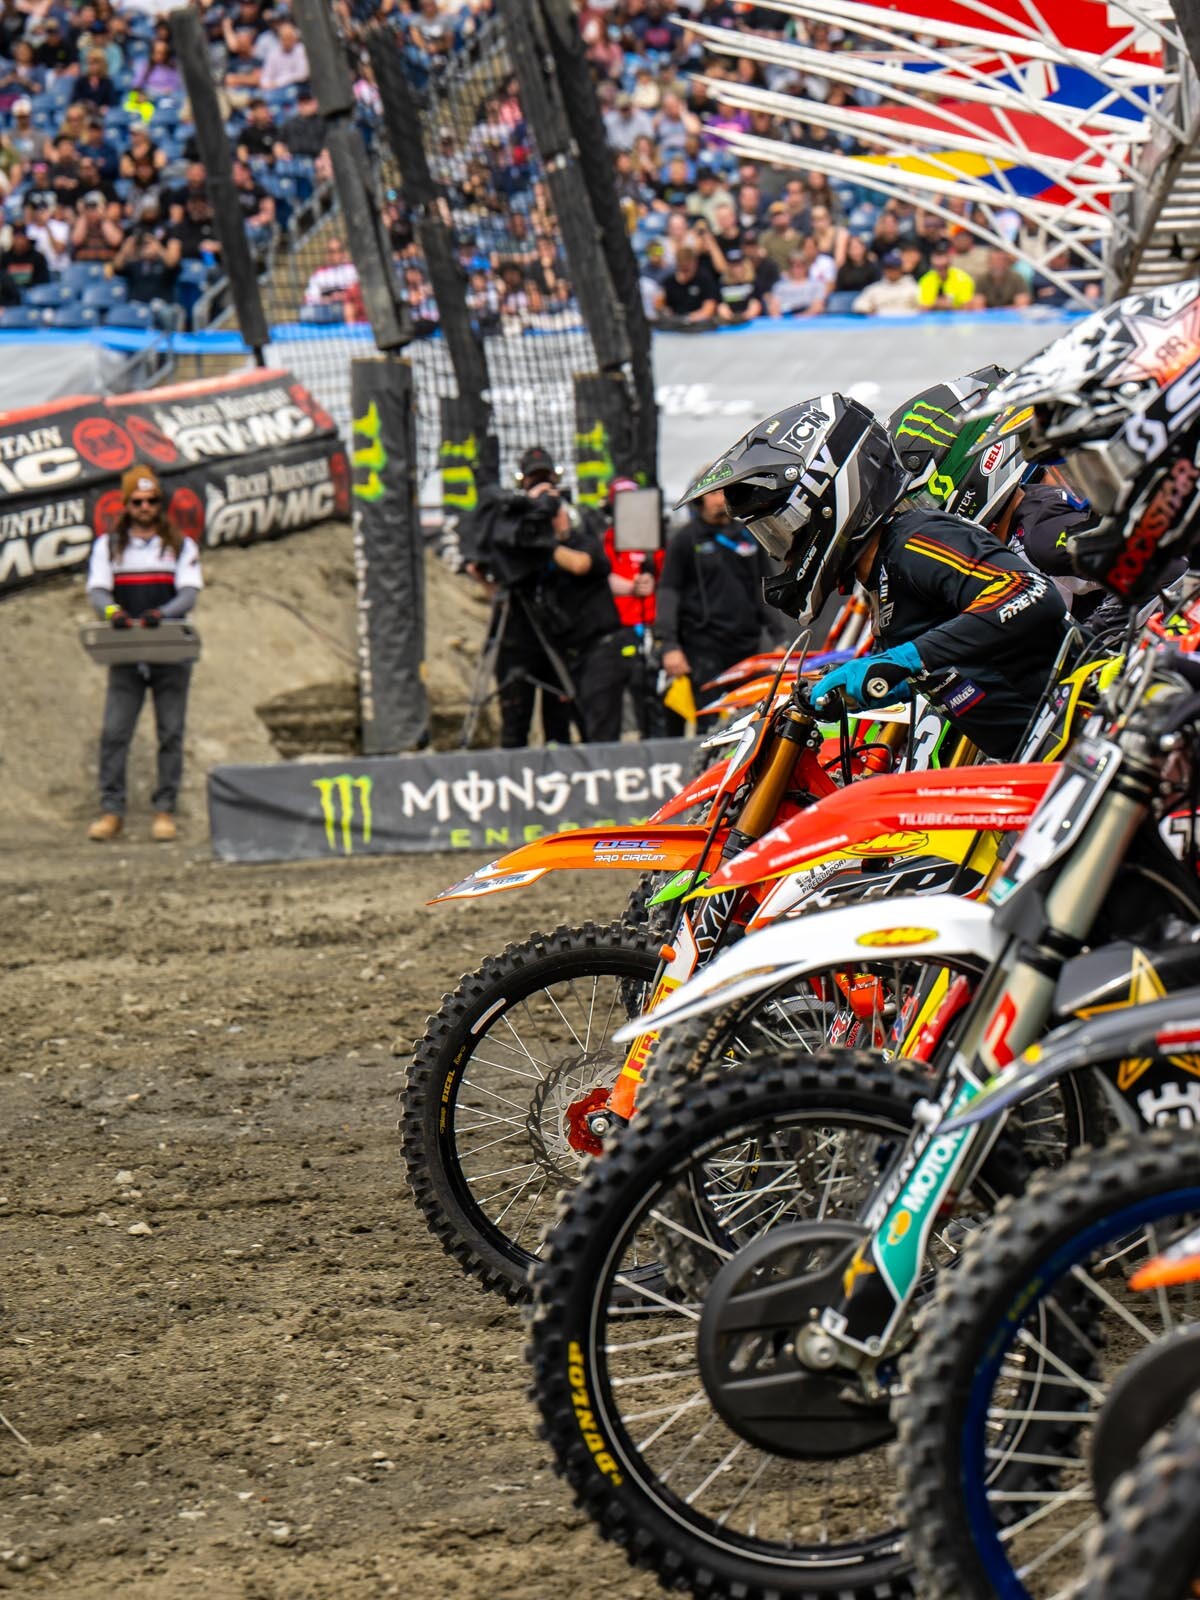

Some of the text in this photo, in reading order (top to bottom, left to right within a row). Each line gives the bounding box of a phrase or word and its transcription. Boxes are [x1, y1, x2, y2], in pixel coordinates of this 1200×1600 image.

[0, 426, 63, 459] TAIN
[984, 440, 1004, 471] BELL
[787, 444, 840, 519] FLY
[401, 762, 684, 823] MONSTER
[621, 854, 666, 862] CIRCUIT
[441, 1070, 455, 1103] EXCEL
